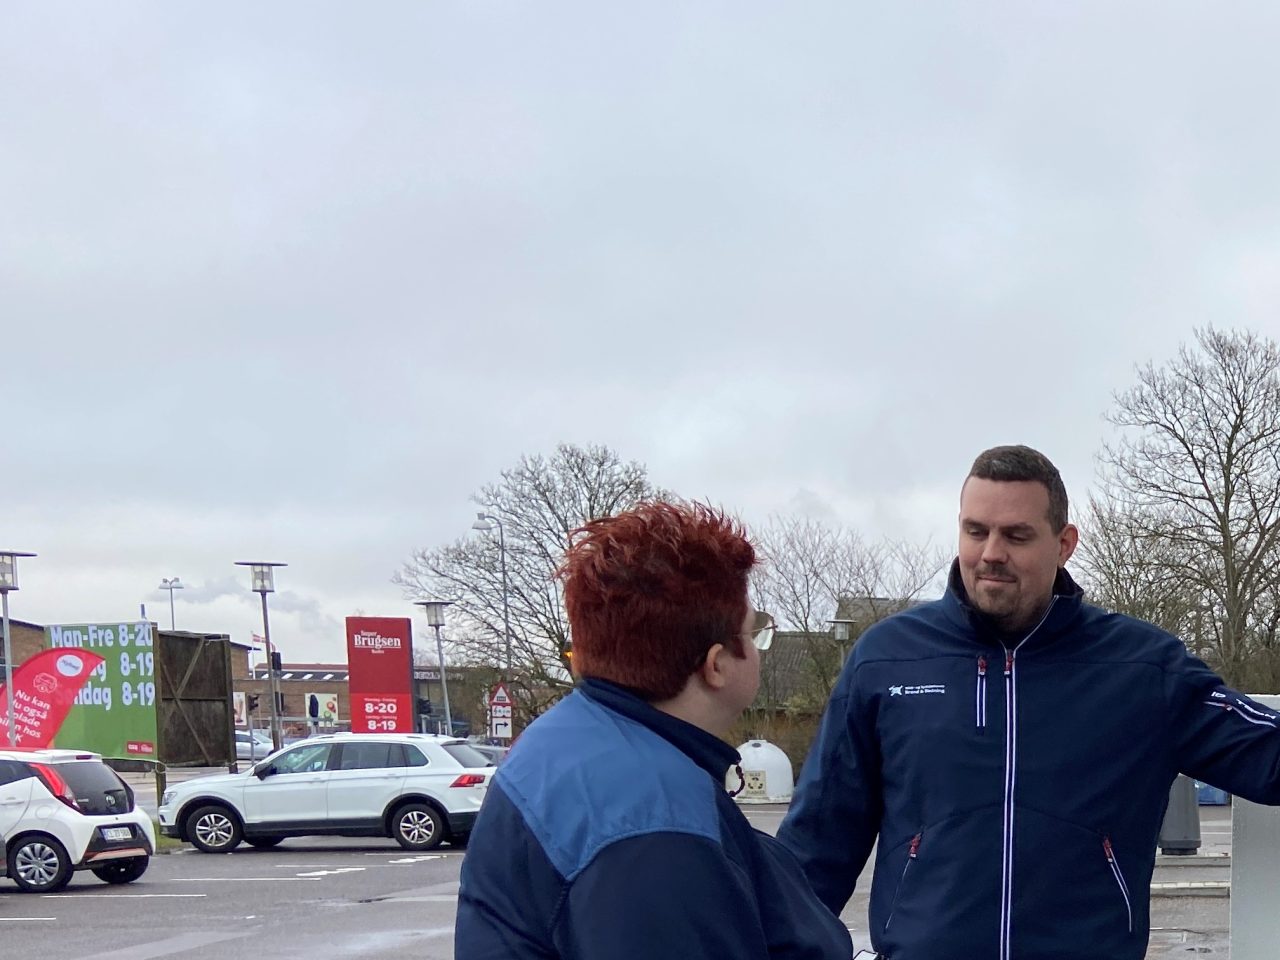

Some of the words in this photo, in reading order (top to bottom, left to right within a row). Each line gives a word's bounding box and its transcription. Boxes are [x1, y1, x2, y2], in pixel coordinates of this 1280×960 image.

[50, 625, 114, 648] Man-Fre
[118, 623, 153, 647] 8-20
[354, 635, 401, 649] Brugsen
[120, 651, 154, 677] 8-19
[15, 689, 31, 702] Nu
[31, 696, 51, 710] kan
[122, 681, 155, 706] 8-19
[23, 704, 48, 719] også
[364, 702, 397, 714] 8-20
[23, 726, 42, 738] hos
[367, 720, 397, 731] 8-19
